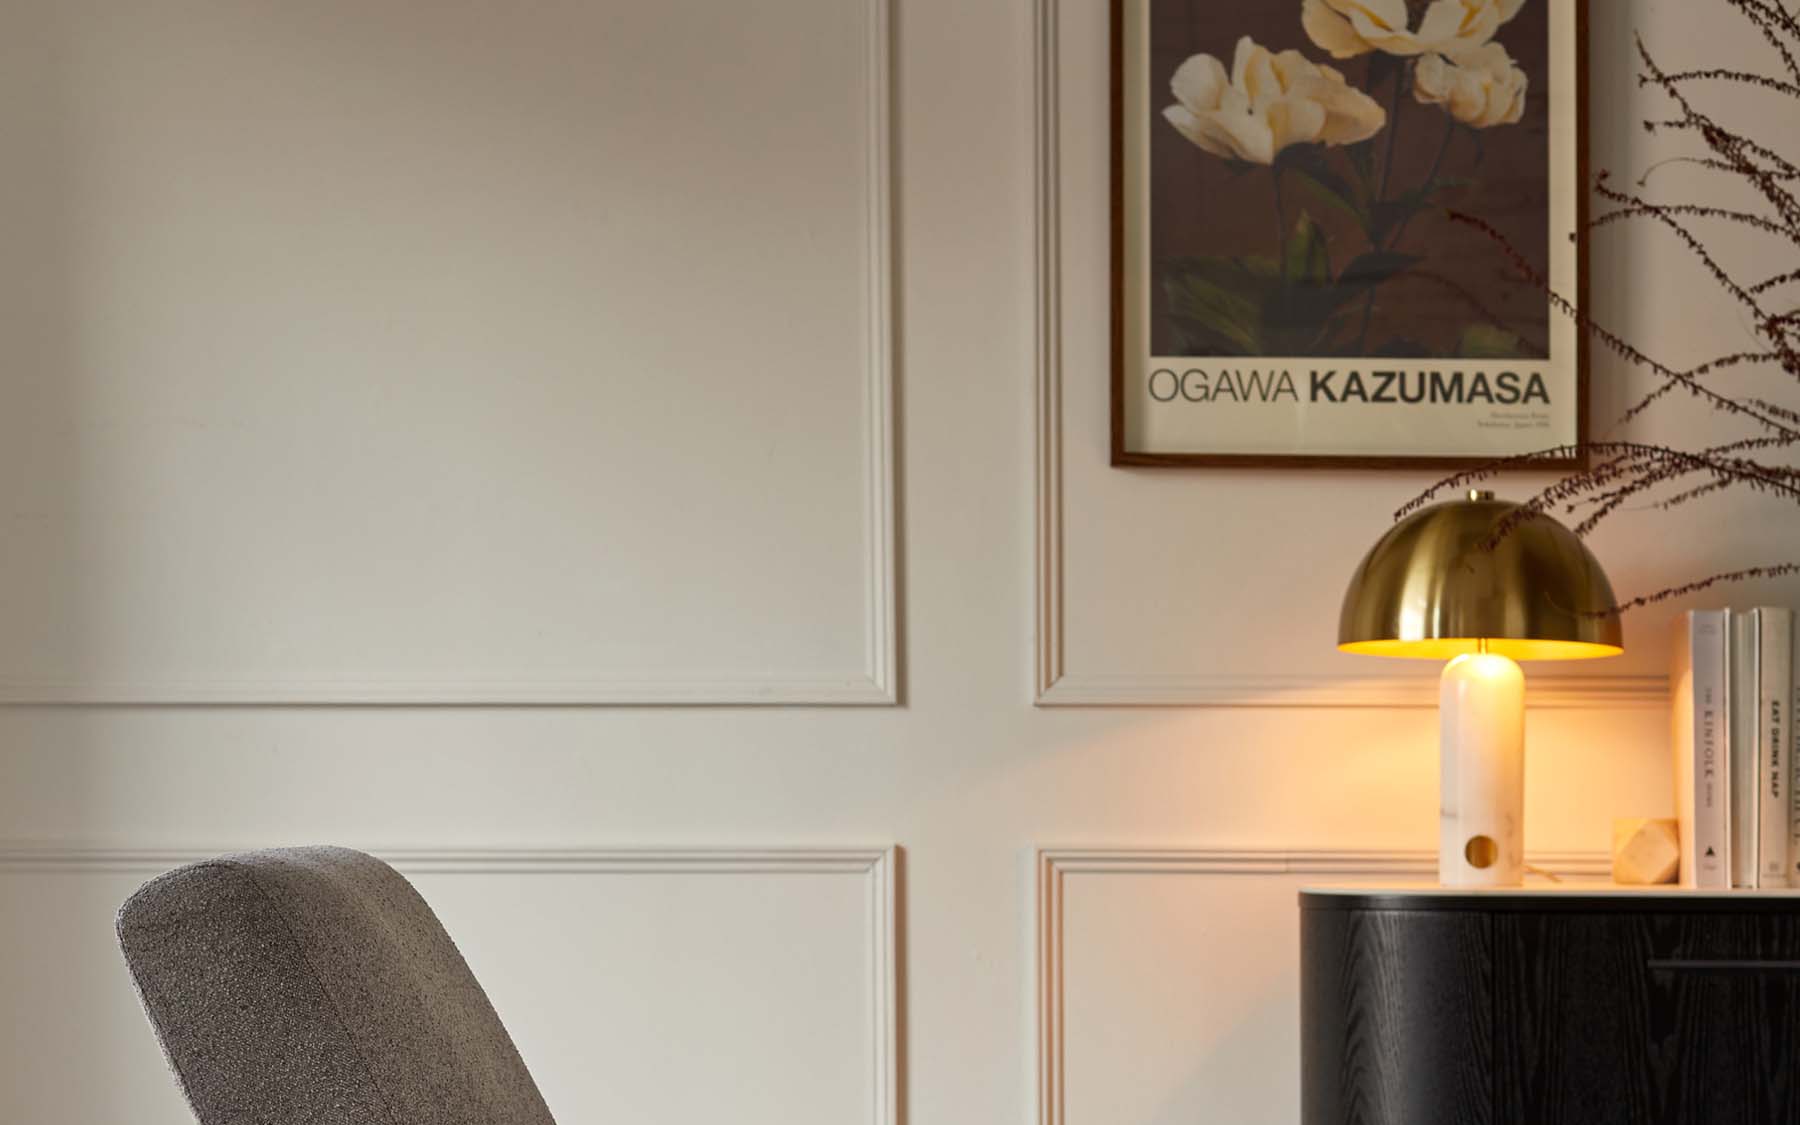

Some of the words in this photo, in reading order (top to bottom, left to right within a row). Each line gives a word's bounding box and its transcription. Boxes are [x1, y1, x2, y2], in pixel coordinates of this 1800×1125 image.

[1148, 368, 1299, 403] OGAWA
[1309, 370, 1551, 405] KAZUMASA
[1771, 700, 1780, 724] EAT
[1704, 709, 1714, 779] KINFOLK
[1771, 727, 1780, 767] DRINK
[1770, 771, 1779, 799] NAP
